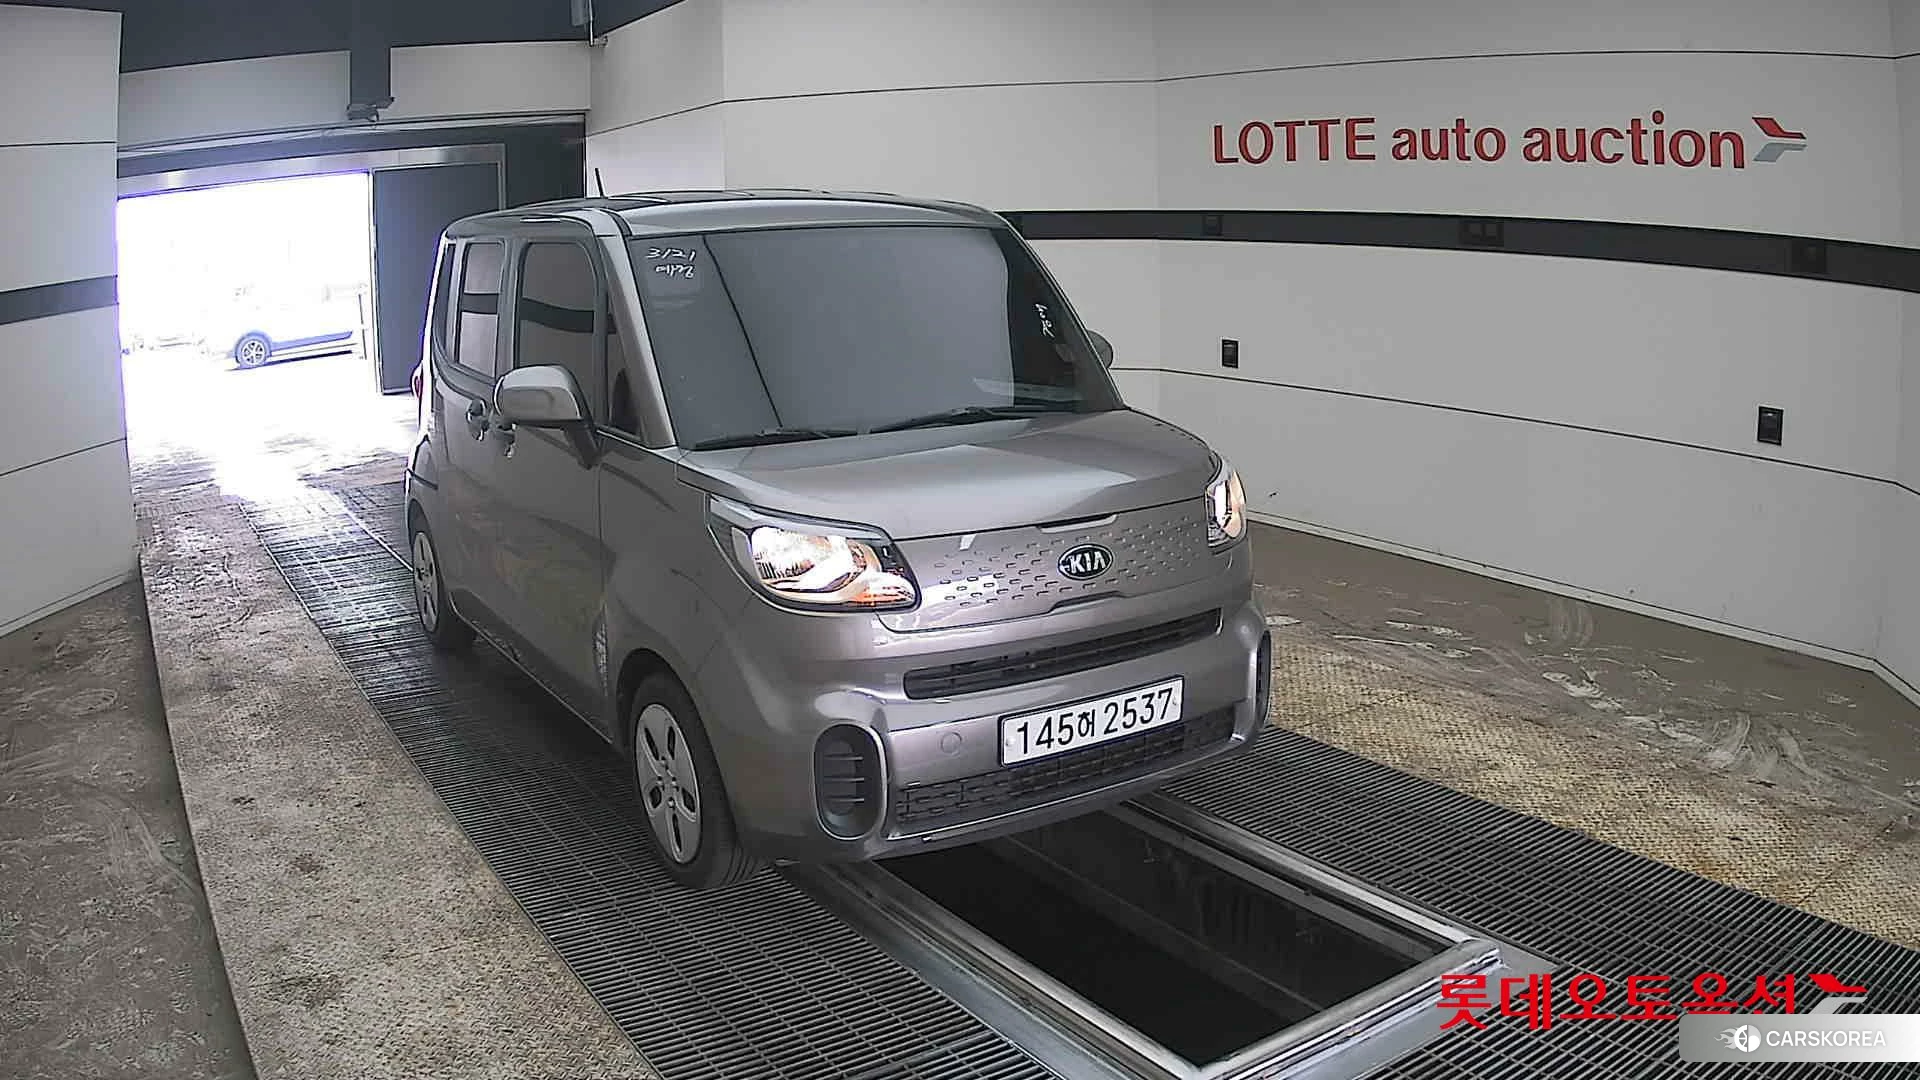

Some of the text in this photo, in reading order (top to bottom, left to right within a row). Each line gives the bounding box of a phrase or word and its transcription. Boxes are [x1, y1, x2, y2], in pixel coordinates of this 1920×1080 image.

[1212, 109, 1746, 170] LOTTE auto auction
[1065, 549, 1108, 576] KIA
[1017, 687, 1173, 755] 145허 2537
